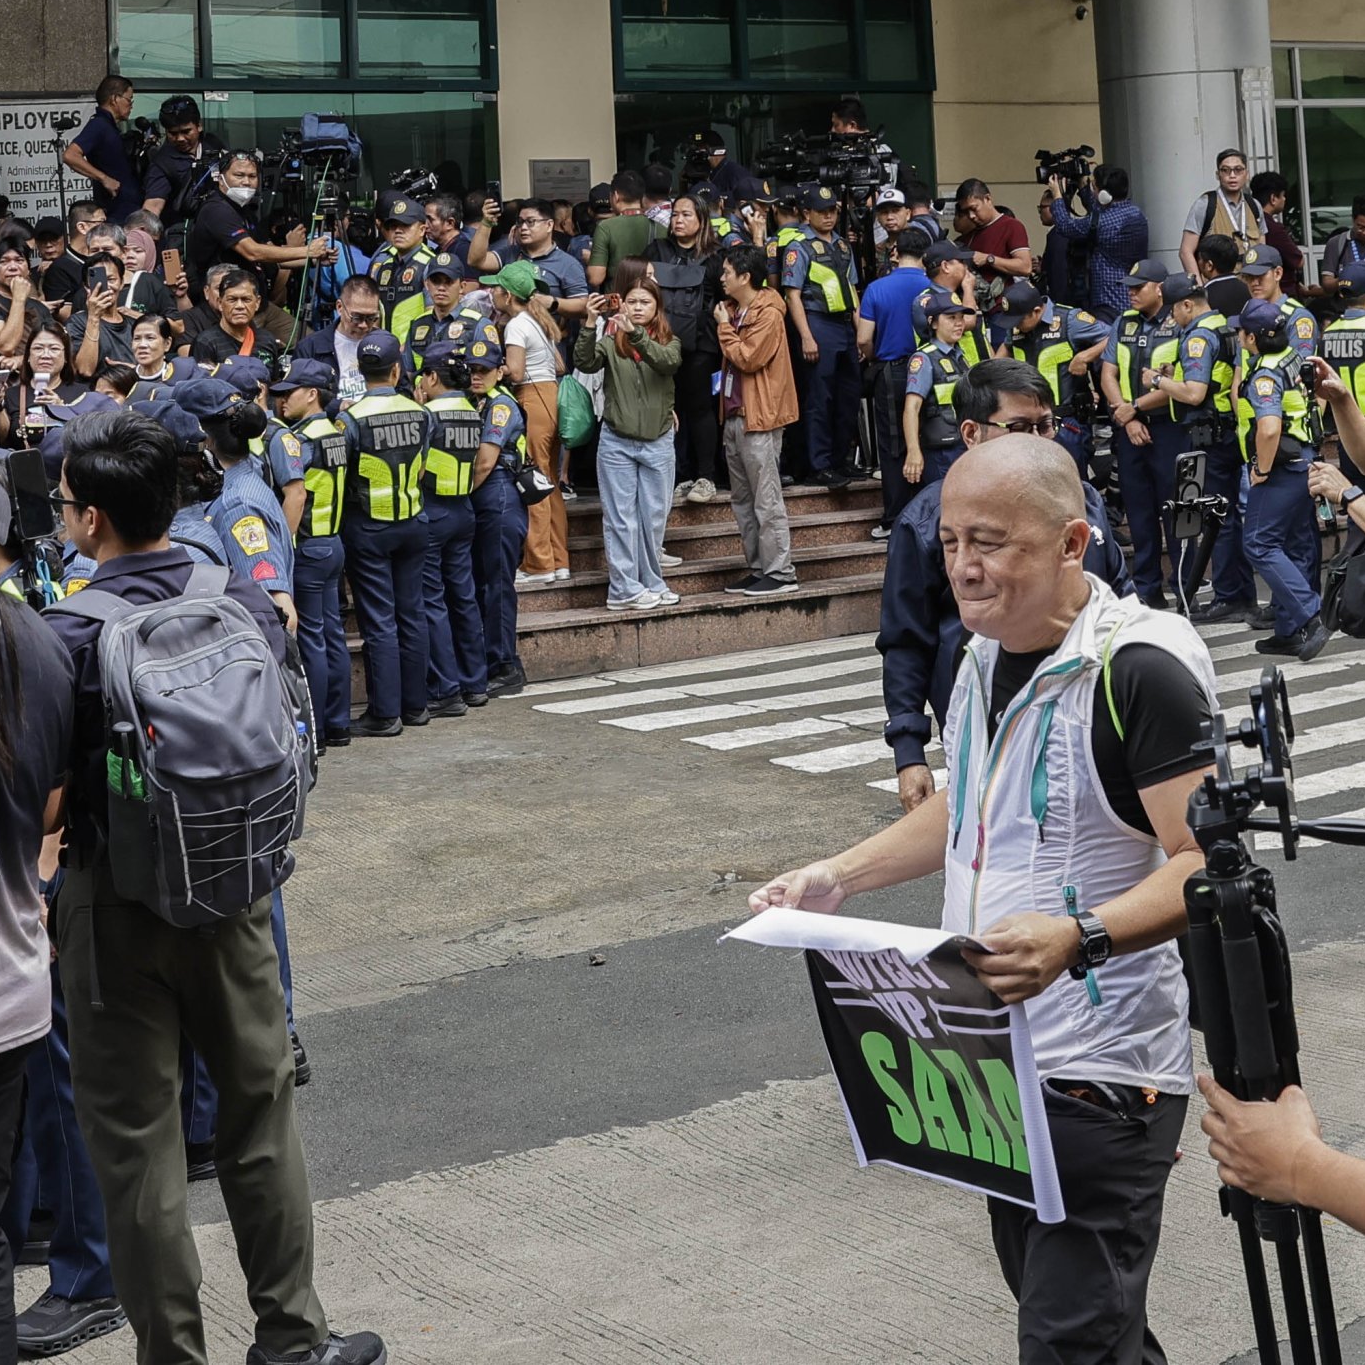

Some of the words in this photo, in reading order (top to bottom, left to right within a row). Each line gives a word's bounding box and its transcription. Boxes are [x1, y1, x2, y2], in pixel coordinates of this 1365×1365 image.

[9, 178, 94, 193] IDENTIFICATIO
[35, 197, 59, 211] part
[1324, 339, 1364, 358] PULIS
[372, 422, 421, 451] PULIS
[445, 427, 481, 449] PULIS
[869, 990, 935, 1038] VP
[859, 1030, 1032, 1175] SARA
